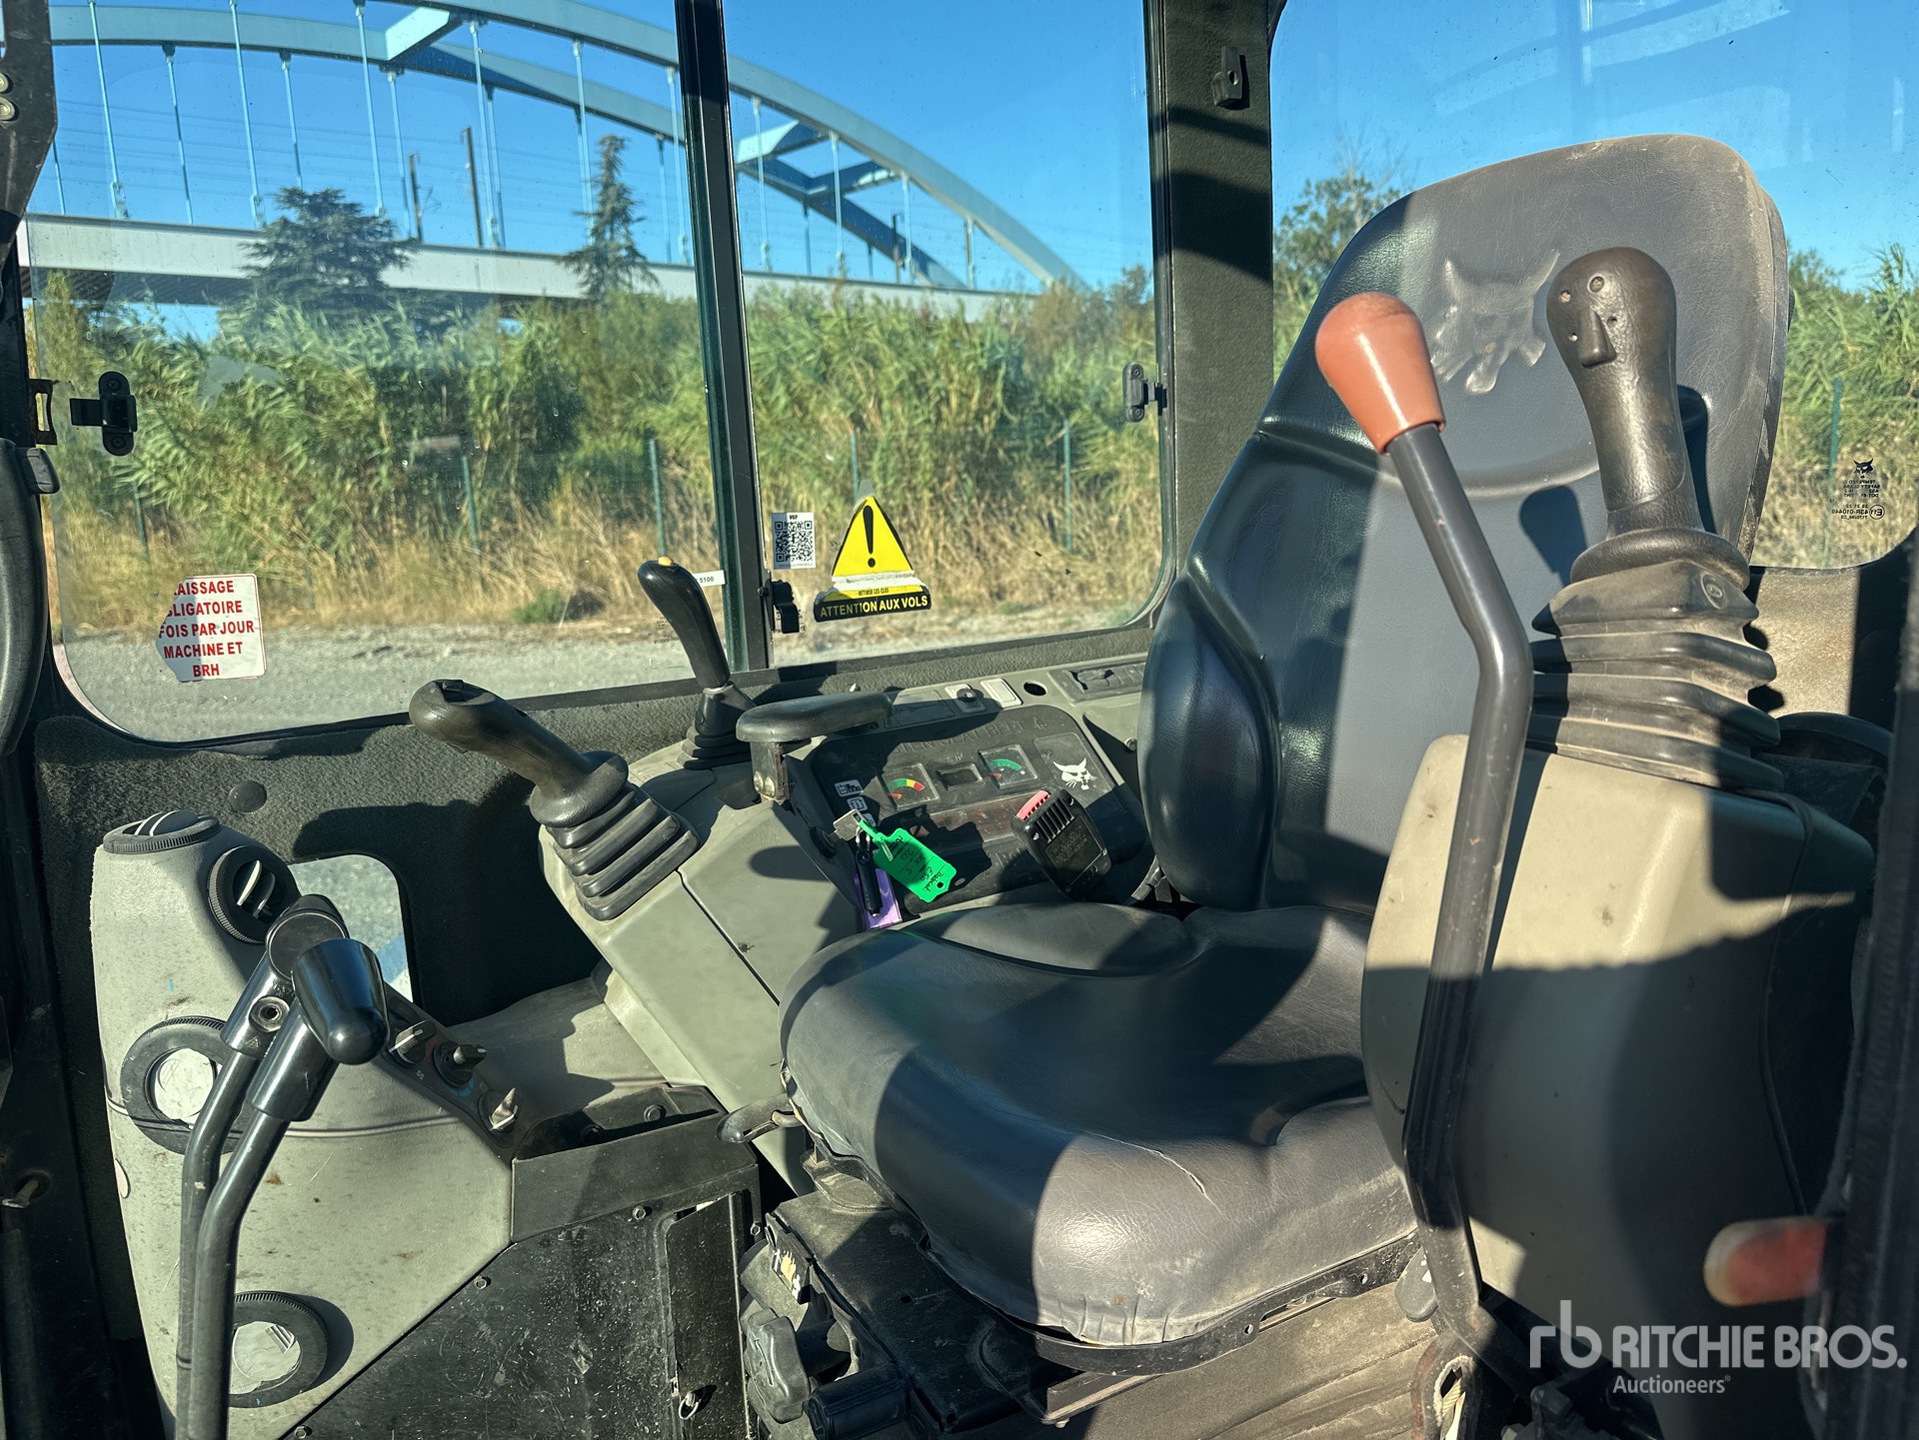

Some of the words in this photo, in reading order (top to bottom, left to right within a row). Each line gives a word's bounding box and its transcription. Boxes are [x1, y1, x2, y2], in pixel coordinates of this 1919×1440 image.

[174, 580, 234, 596] AISSAGE
[820, 601, 878, 617] ATTENTION
[879, 598, 900, 611] AUX
[901, 595, 928, 609] VOLS
[191, 623, 217, 637] PAR
[220, 620, 255, 635] JOUR
[163, 643, 224, 659] MACHINE
[227, 641, 243, 655] ET
[192, 664, 220, 677] BRH
